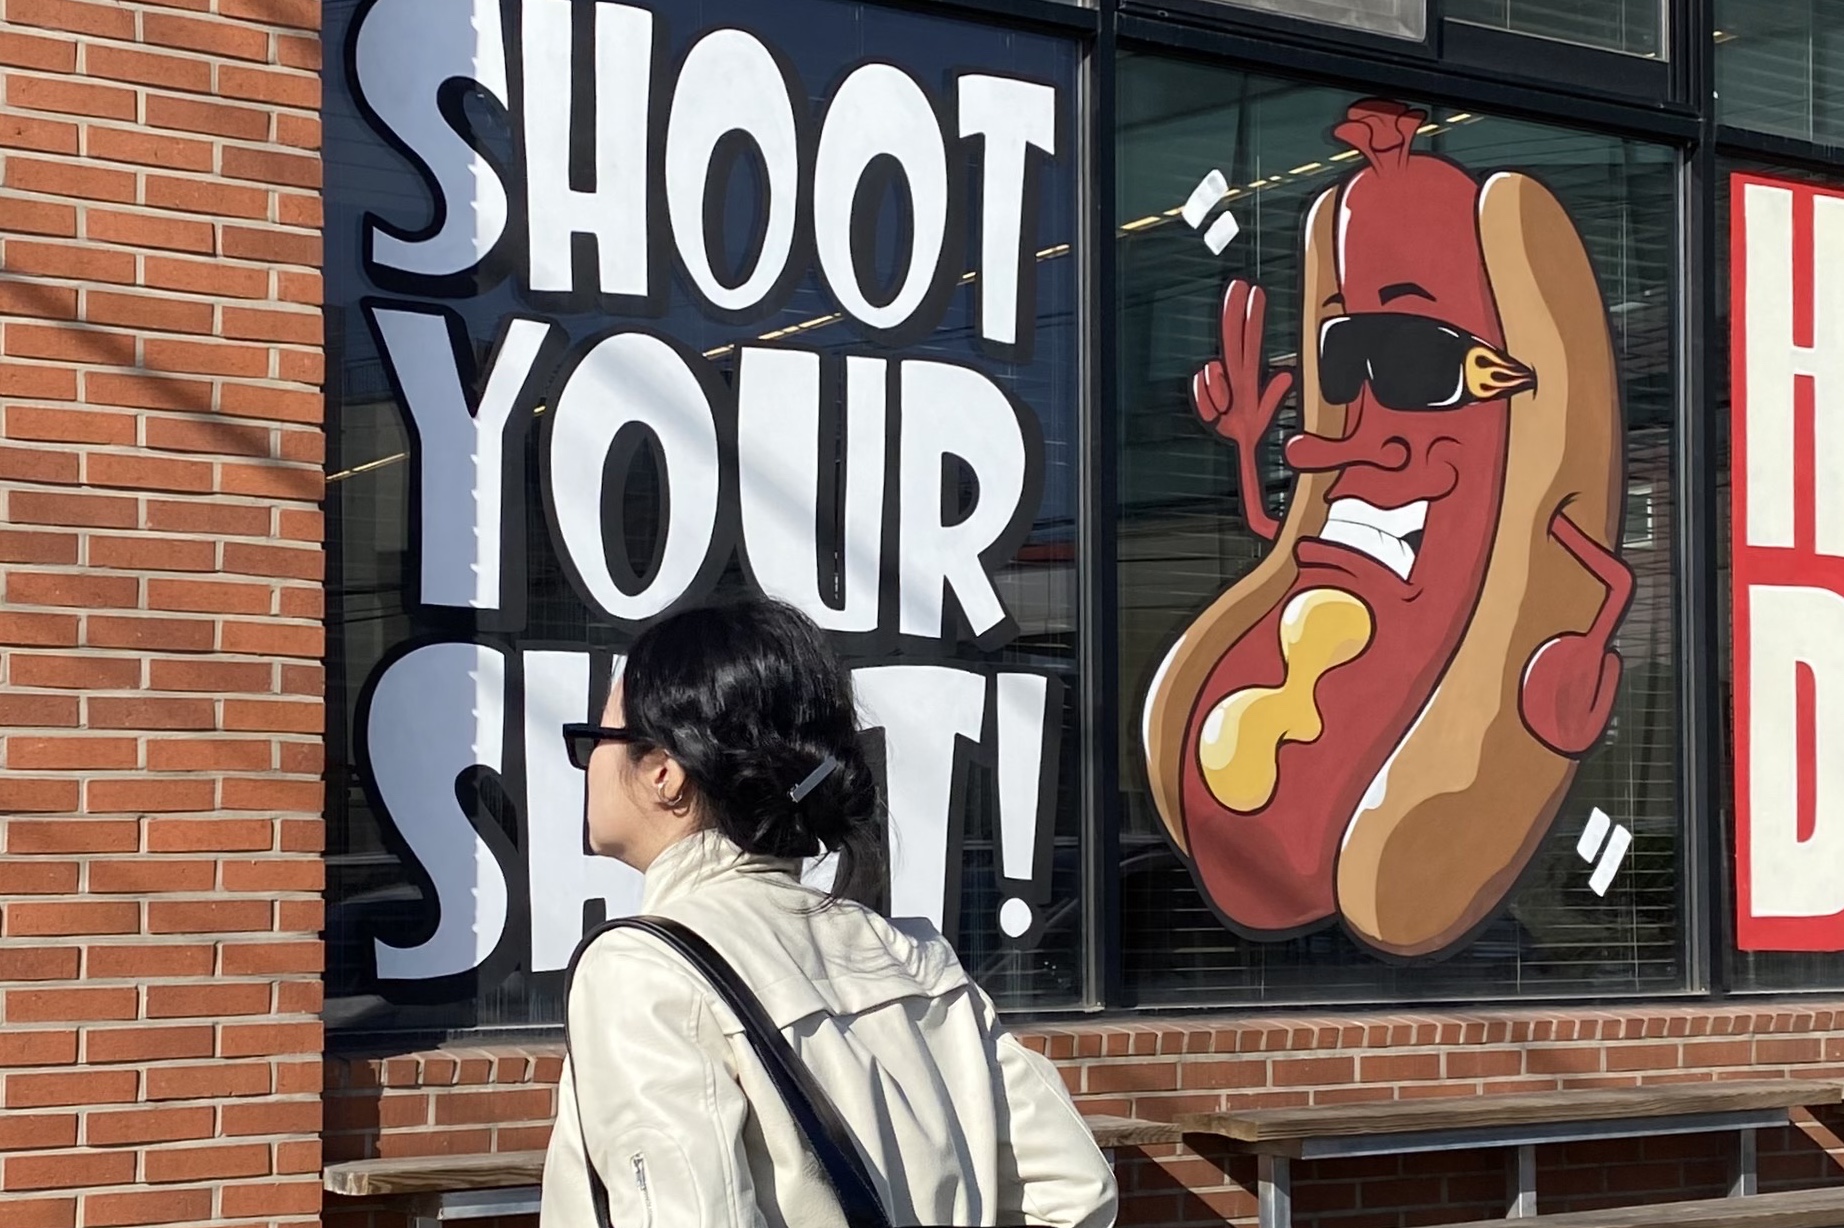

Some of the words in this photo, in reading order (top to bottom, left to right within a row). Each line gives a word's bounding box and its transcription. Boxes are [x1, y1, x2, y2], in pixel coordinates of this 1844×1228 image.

[356, 0, 1056, 345] SHOOT
[372, 307, 1027, 638] YOUR
[368, 642, 1047, 979] SHT!
